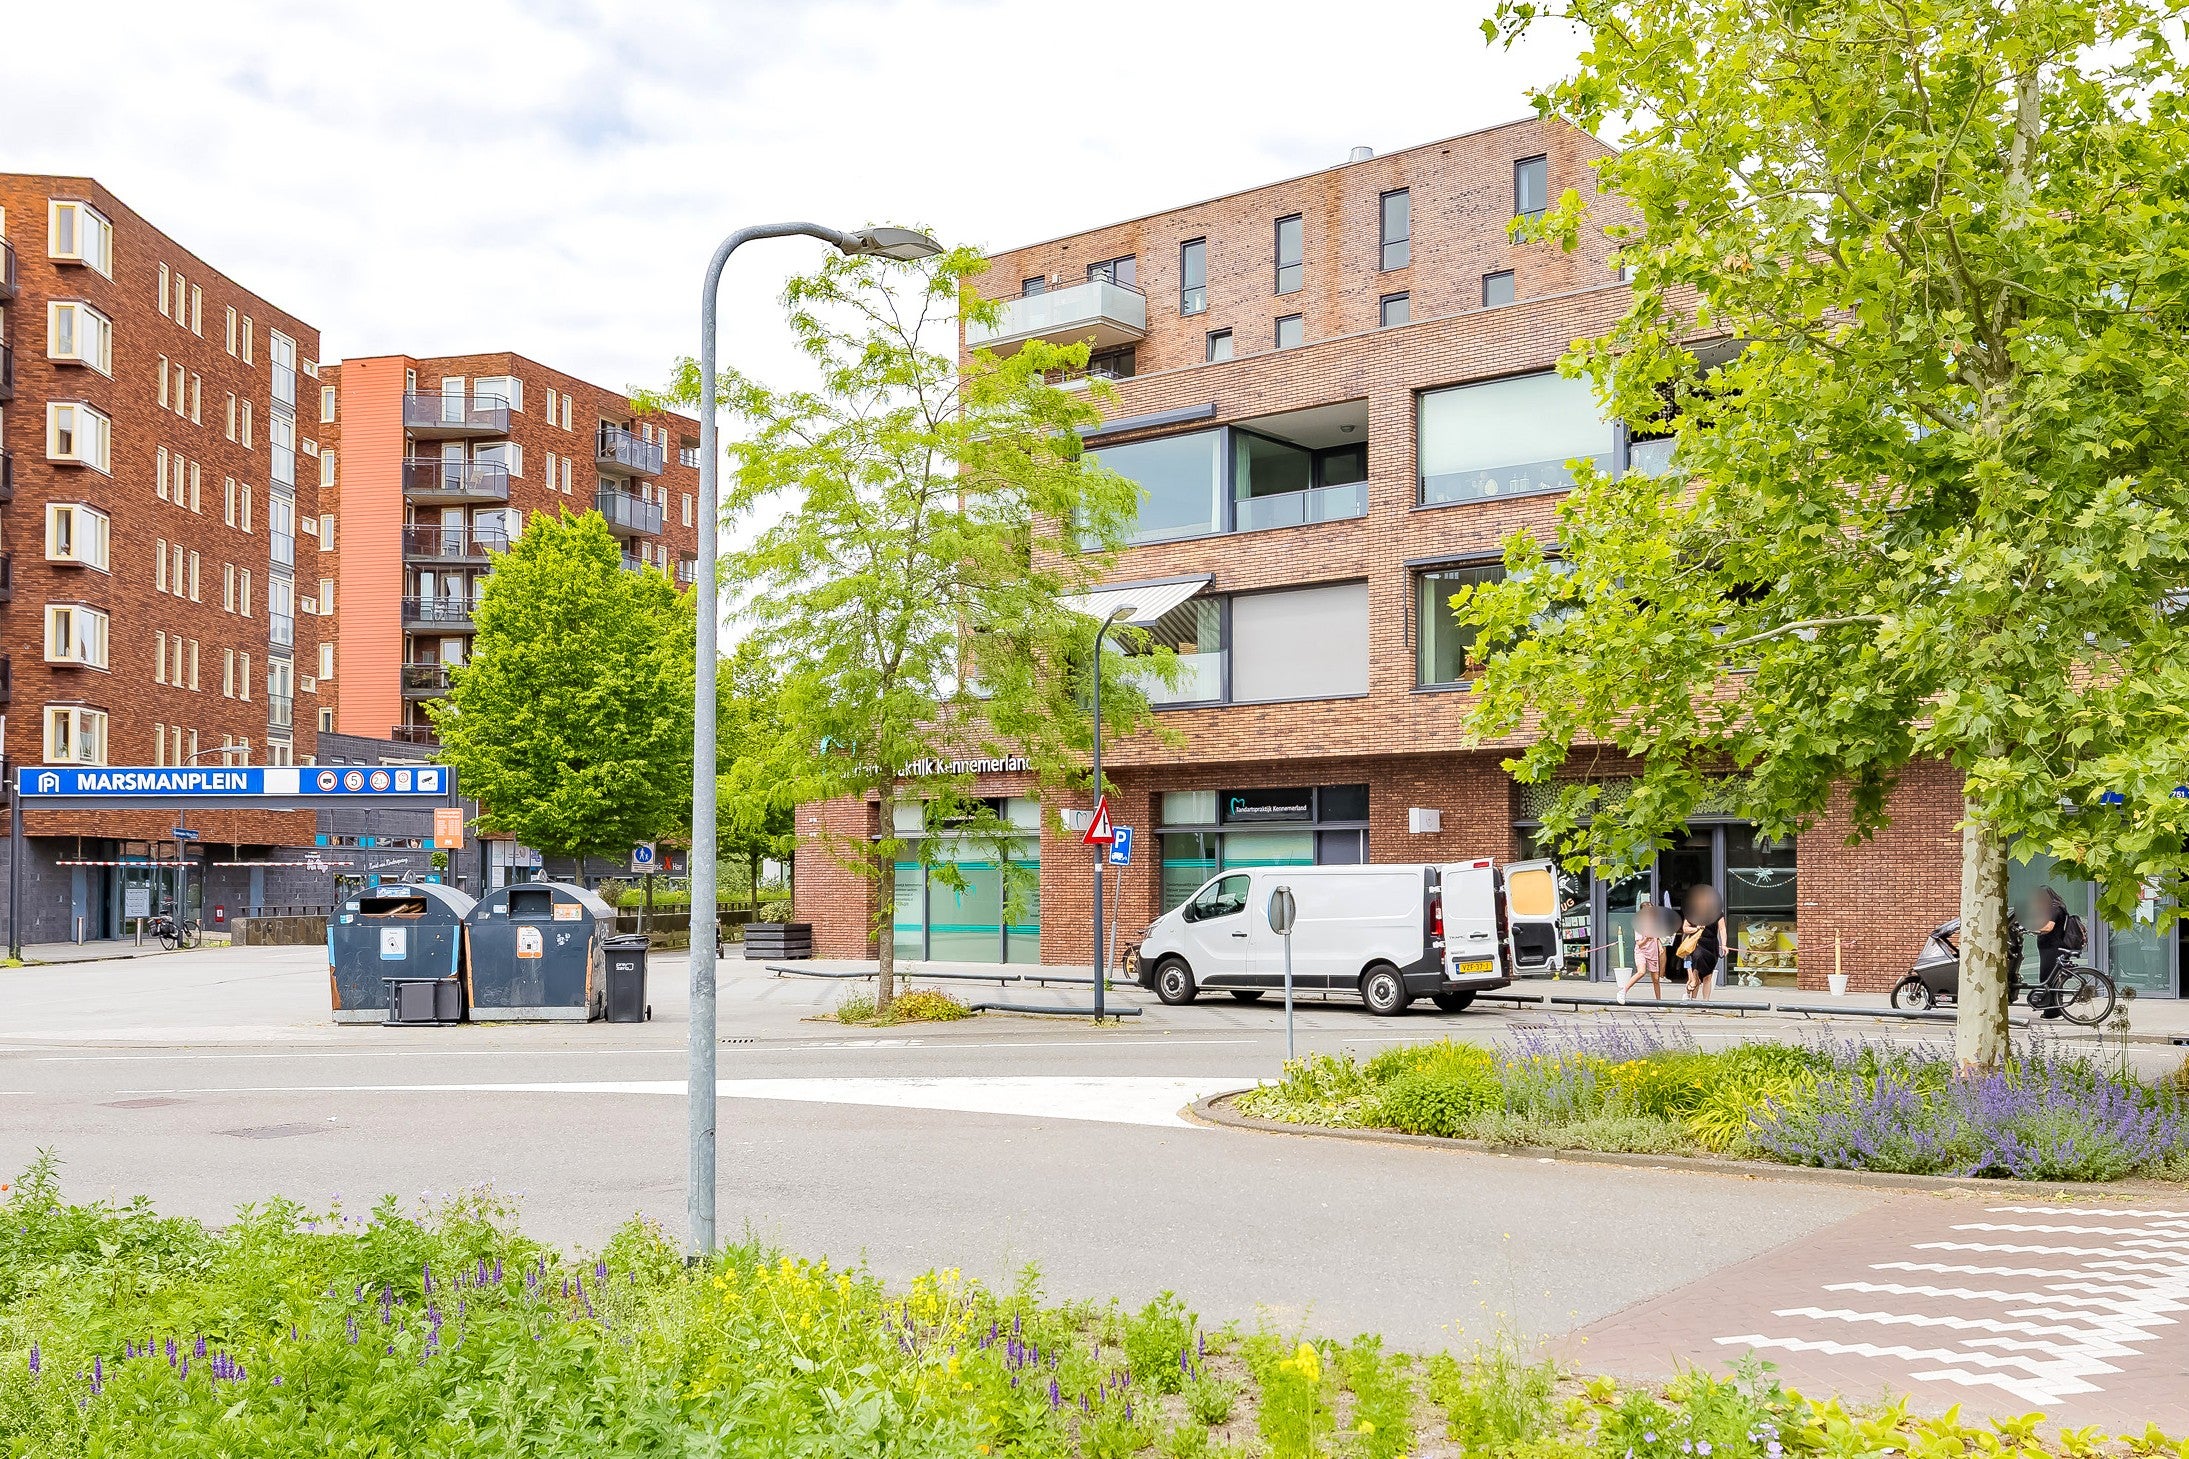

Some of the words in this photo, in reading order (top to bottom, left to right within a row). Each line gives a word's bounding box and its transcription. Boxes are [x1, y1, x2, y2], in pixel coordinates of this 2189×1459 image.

[77, 773, 247, 790] MARSMANPLEIN
[350, 775, 358, 787] 5
[1115, 831, 1127, 849] P
[1560, 898, 1575, 912] UG
